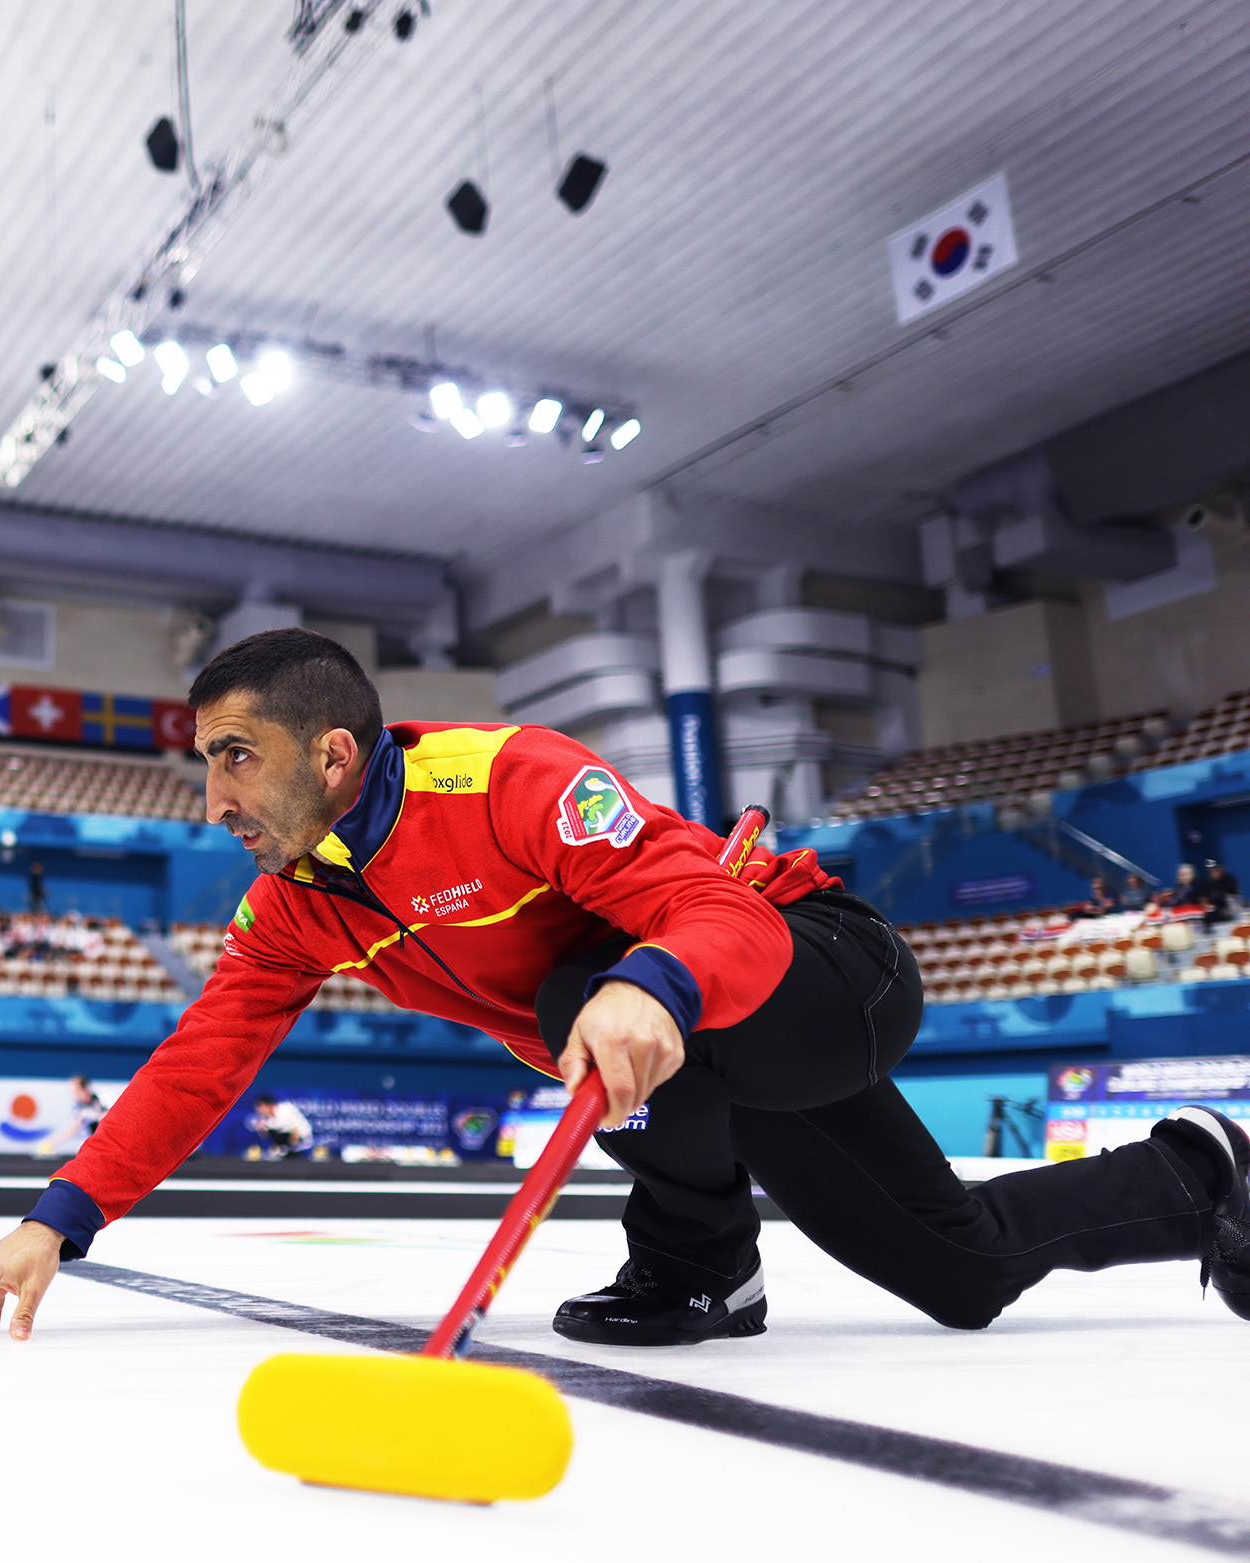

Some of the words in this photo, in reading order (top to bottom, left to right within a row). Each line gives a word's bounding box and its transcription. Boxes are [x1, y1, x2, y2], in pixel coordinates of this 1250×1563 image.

[430, 771, 473, 792] oxglide
[561, 821, 572, 840] 2023
[615, 815, 637, 844] CURLING
[617, 812, 631, 832] WORLD
[430, 878, 483, 906] FEDHIELO
[434, 898, 470, 917] ESPAÑA
